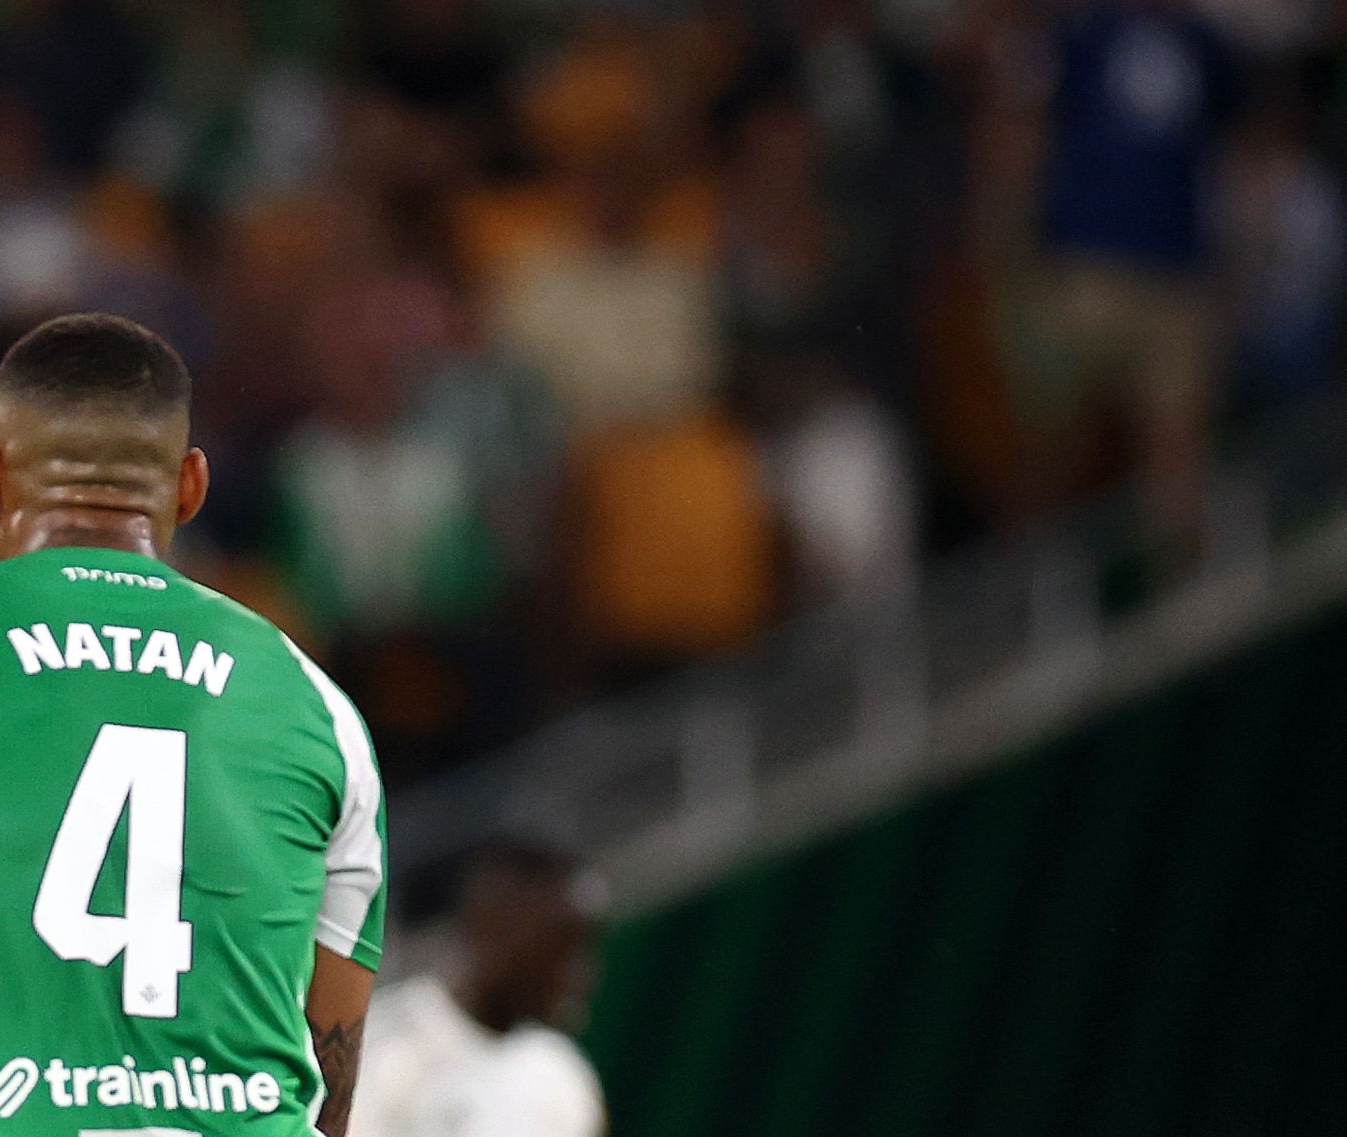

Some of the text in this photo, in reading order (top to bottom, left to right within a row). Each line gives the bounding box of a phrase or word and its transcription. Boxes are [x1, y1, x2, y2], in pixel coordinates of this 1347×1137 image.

[61, 566, 167, 590] prima
[7, 622, 234, 697] NATAN
[33, 723, 192, 1019] 4
[44, 1054, 280, 1113] trainline
